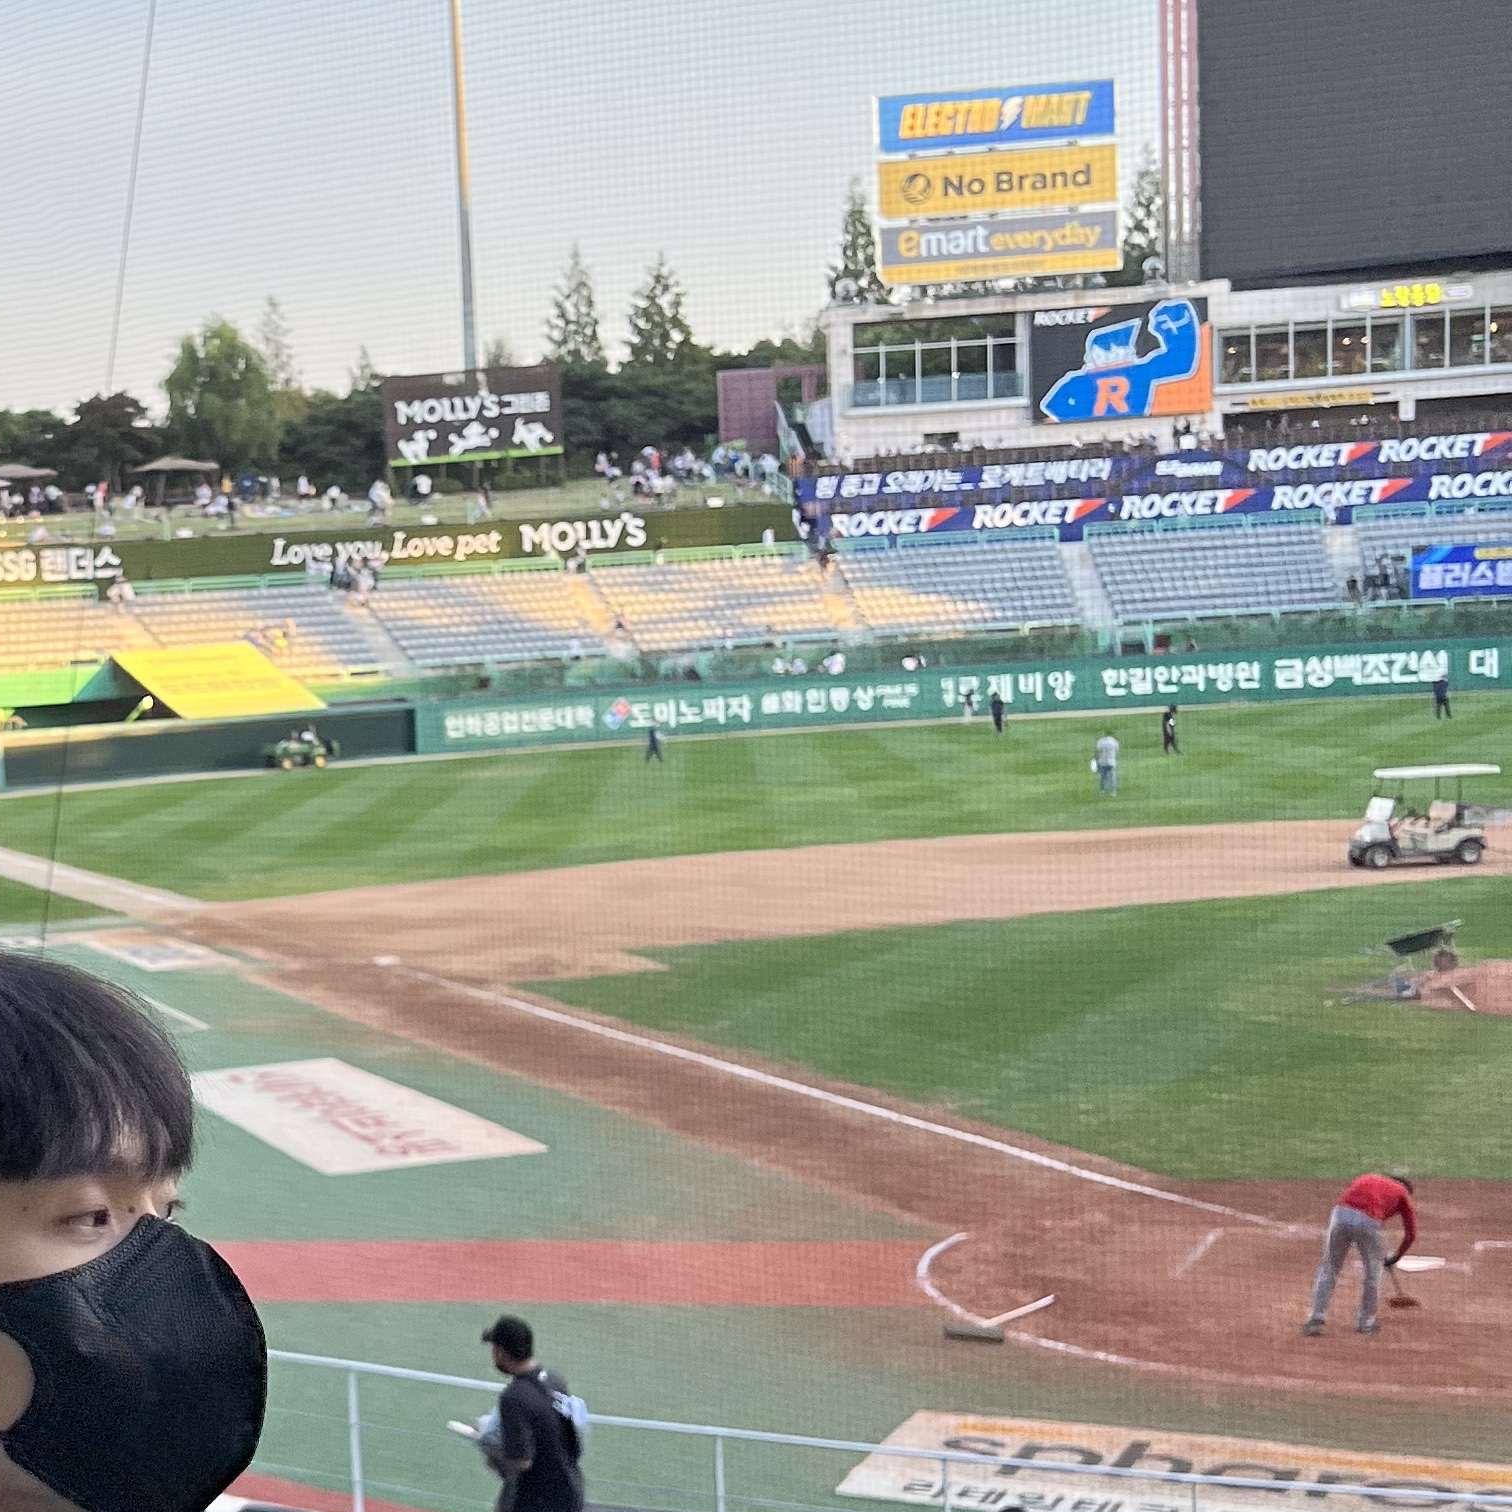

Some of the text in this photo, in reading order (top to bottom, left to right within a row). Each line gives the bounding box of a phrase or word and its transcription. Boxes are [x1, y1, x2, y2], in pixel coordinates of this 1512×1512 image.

[943, 163, 1092, 197] No Brand
[898, 220, 1101, 258] emart everyday
[1033, 307, 1096, 327] ROCKET
[1093, 377, 1131, 416] R
[1248, 442, 1355, 472] ROCKET
[1378, 432, 1491, 463] ROCKET
[1272, 478, 1388, 510] ROCKET
[1428, 470, 1512, 500] ROCK
[972, 498, 1083, 530] ROCKET
[1120, 488, 1233, 520] ROCKET
[831, 507, 938, 538] ROCKET
[270, 538, 332, 566] Love
[391, 530, 454, 558] Love
[454, 529, 502, 561] pet
[630, 695, 753, 729] 도미노피자
